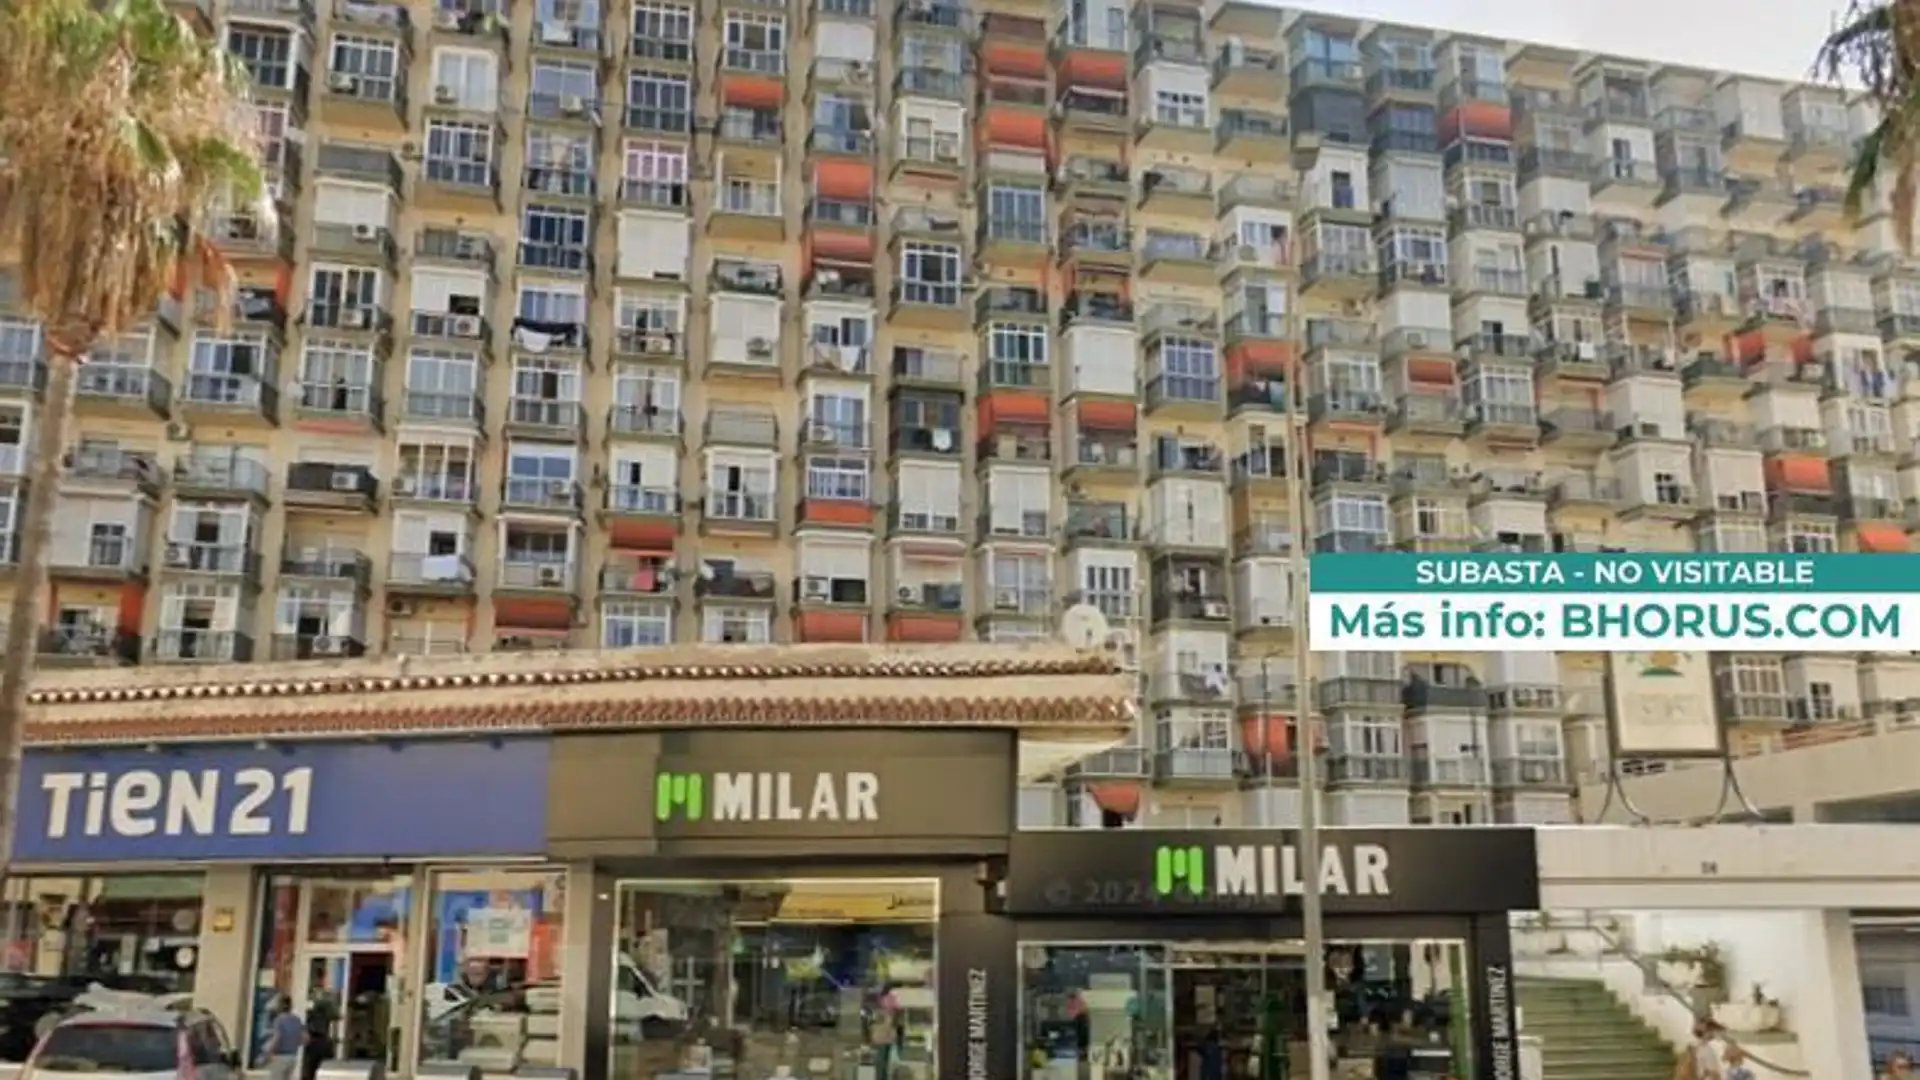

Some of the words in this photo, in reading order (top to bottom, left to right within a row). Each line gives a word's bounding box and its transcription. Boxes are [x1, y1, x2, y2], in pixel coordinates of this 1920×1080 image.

[230, 767, 314, 834] 21
[713, 772, 879, 820] MILAR
[1216, 846, 1390, 895] MILAR
